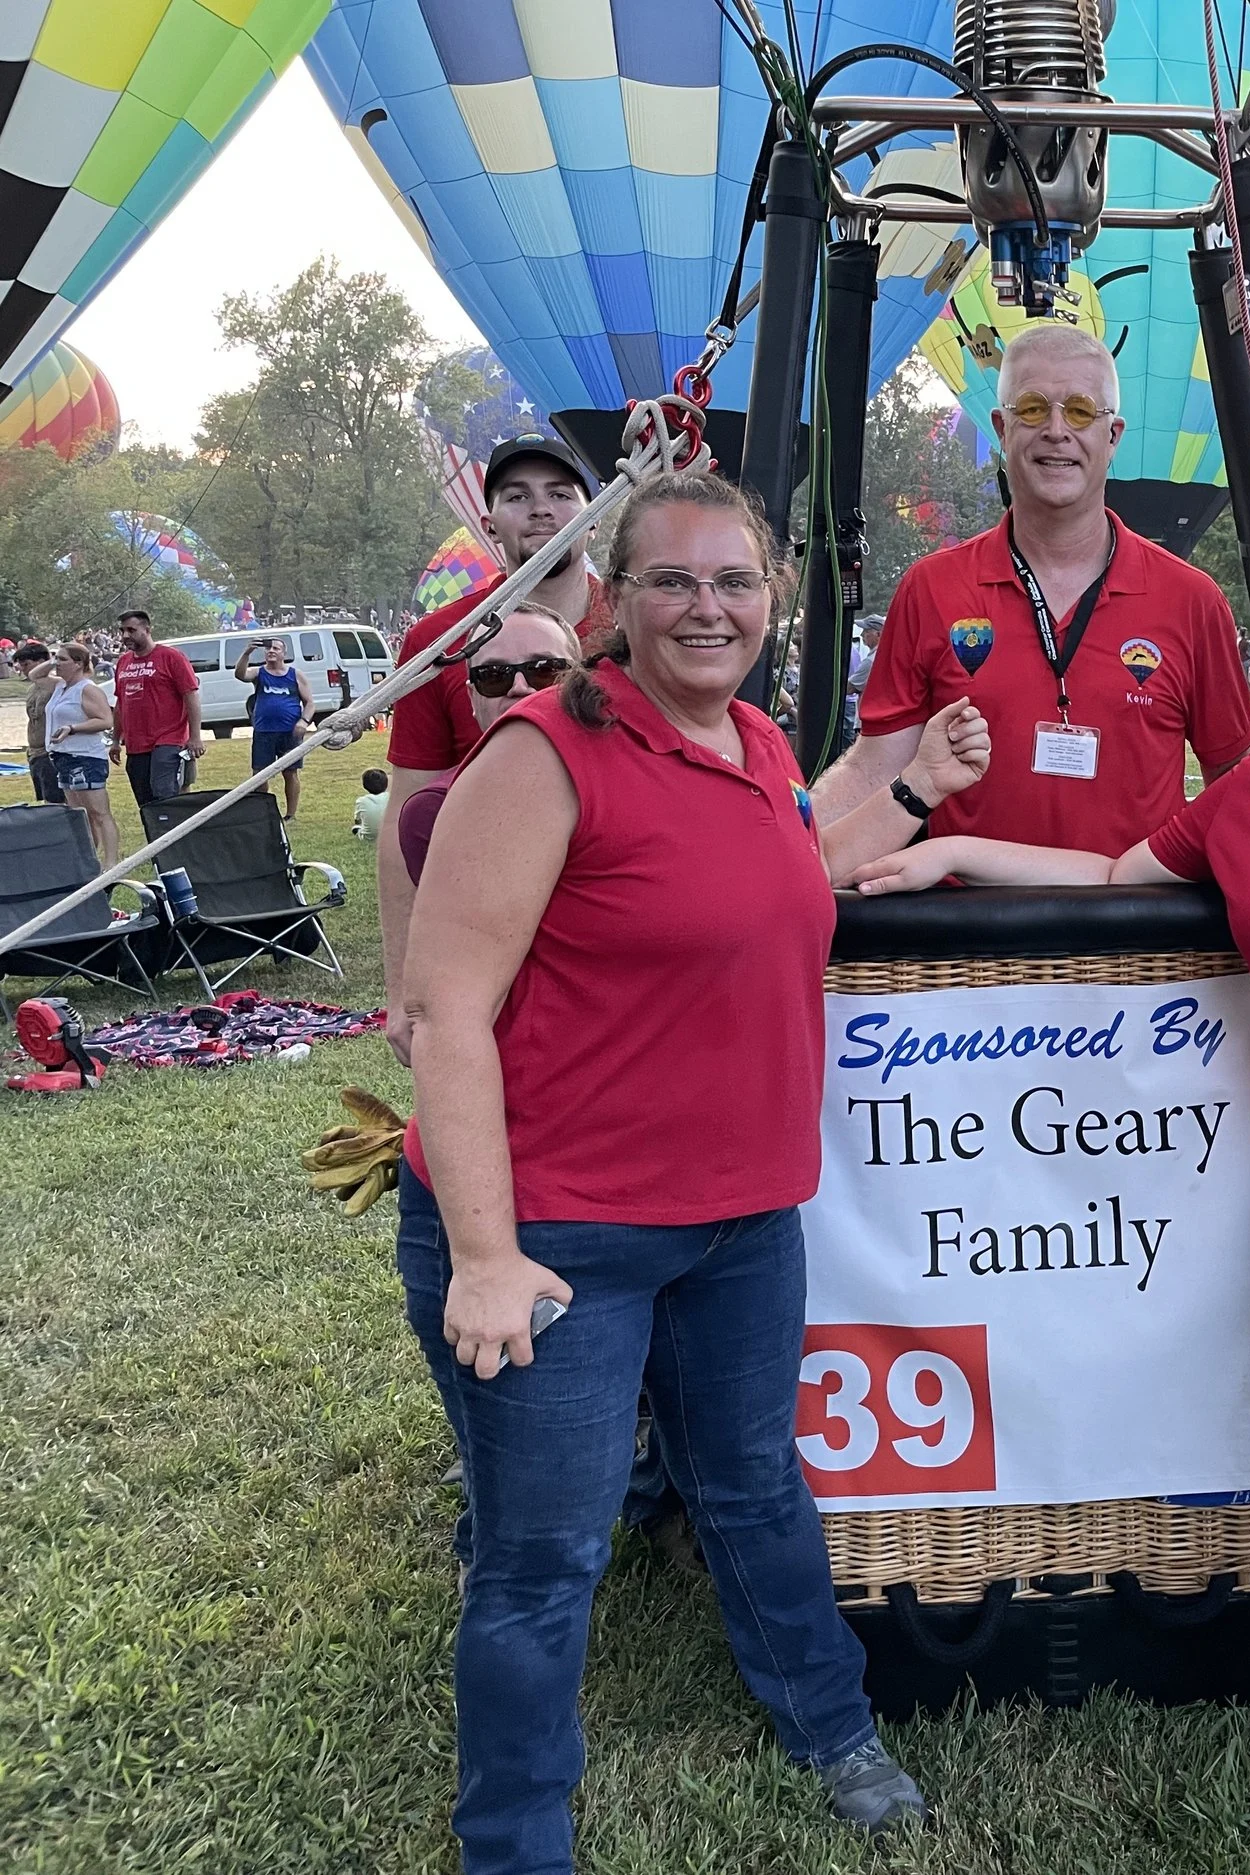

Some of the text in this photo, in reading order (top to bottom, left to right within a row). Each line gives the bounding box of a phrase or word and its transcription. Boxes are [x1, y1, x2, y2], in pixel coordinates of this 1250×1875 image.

[138, 668, 157, 677] Day
[1126, 692, 1153, 705] Kevin
[838, 997, 1228, 1084] Sponsored By
[848, 1086, 1231, 1174] The Geary
[921, 1195, 1172, 1292] Family
[795, 1350, 975, 1471] 39
